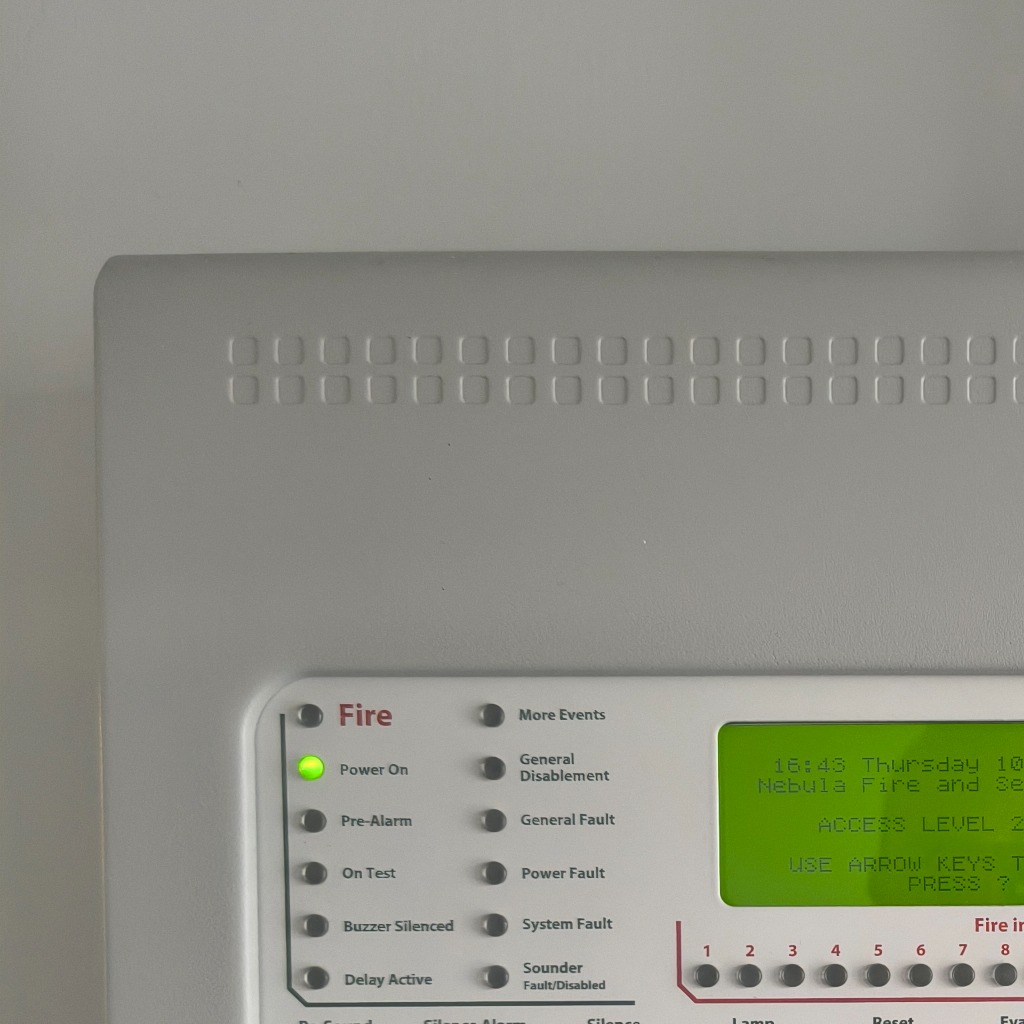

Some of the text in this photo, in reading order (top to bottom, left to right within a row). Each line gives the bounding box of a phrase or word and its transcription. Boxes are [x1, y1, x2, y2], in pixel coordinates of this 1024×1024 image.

[340, 703, 392, 726] Fire
[519, 709, 605, 720] More Events
[520, 753, 574, 765] General
[775, 758, 845, 773] 16:43
[862, 756, 979, 774] Thursday
[998, 756, 1023, 772] 10
[341, 764, 408, 775] Power On
[521, 769, 609, 781] Disablement
[758, 778, 846, 794] Nebula
[862, 777, 920, 793] Fire
[937, 777, 979, 793] and
[342, 815, 412, 826] Pre-Alarm
[521, 813, 615, 825] General Fault
[818, 816, 906, 833] ACCESS
[922, 816, 995, 832] LEVEL
[1011, 816, 1024, 832] 2
[789, 856, 832, 873] USE
[849, 856, 921, 872] ARROW
[938, 855, 995, 872] KEYS
[343, 868, 396, 879] On Test
[522, 867, 605, 879] Power Fault
[908, 876, 980, 892] PRESS
[997, 875, 1010, 891] ?
[344, 920, 454, 932] Buzzer Silenced
[523, 917, 612, 932] System Fault
[975, 918, 1008, 932] Fire
[704, 945, 709, 957] 1
[746, 945, 754, 957] 2
[789, 945, 797, 956] 3
[831, 945, 840, 956] 4
[875, 945, 882, 956] 5
[917, 944, 925, 956] 6
[959, 944, 967, 955] 7
[1001, 944, 1009, 955] 8
[524, 962, 583, 973] Sounder
[345, 974, 432, 988] Delay Active
[524, 980, 605, 990] Fault/Disabled
